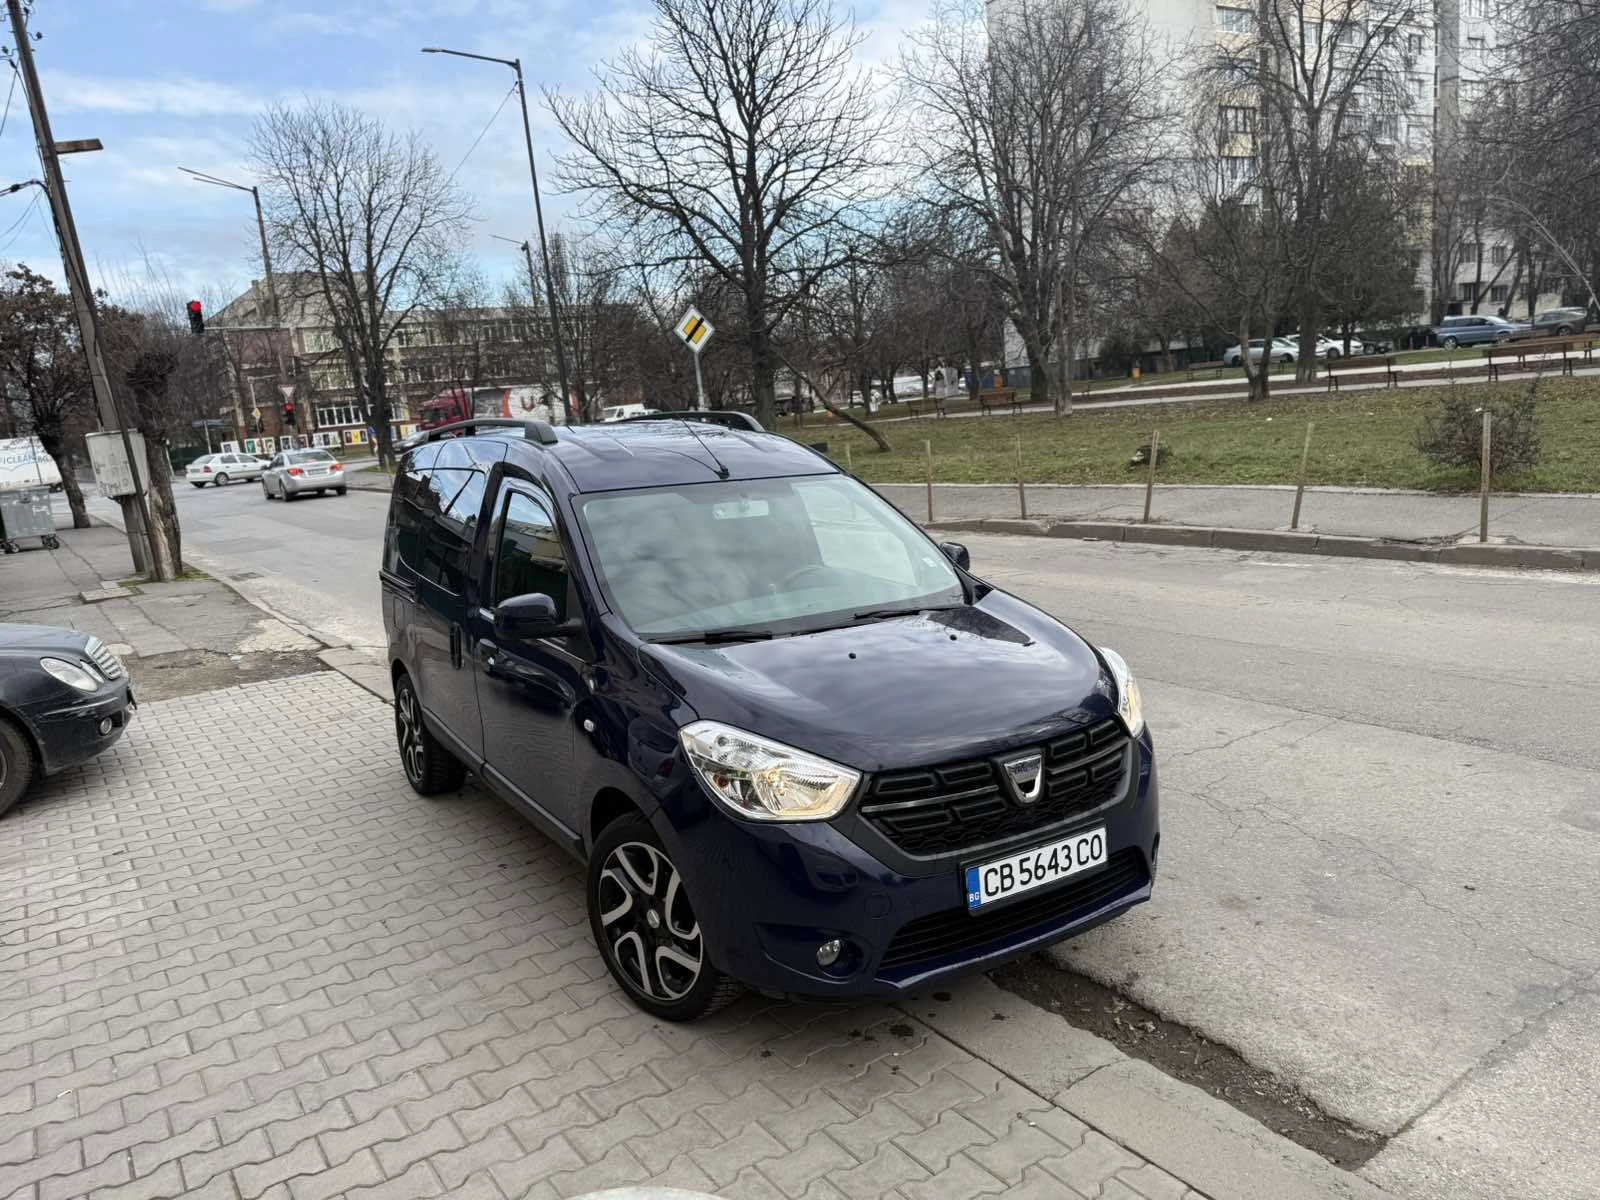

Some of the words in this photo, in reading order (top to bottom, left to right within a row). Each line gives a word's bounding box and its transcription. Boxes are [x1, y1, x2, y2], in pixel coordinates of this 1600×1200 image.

[984, 862, 1015, 897] CB
[1019, 844, 1073, 886] 5643
[1076, 833, 1103, 866] CO
[969, 891, 980, 902] BG
